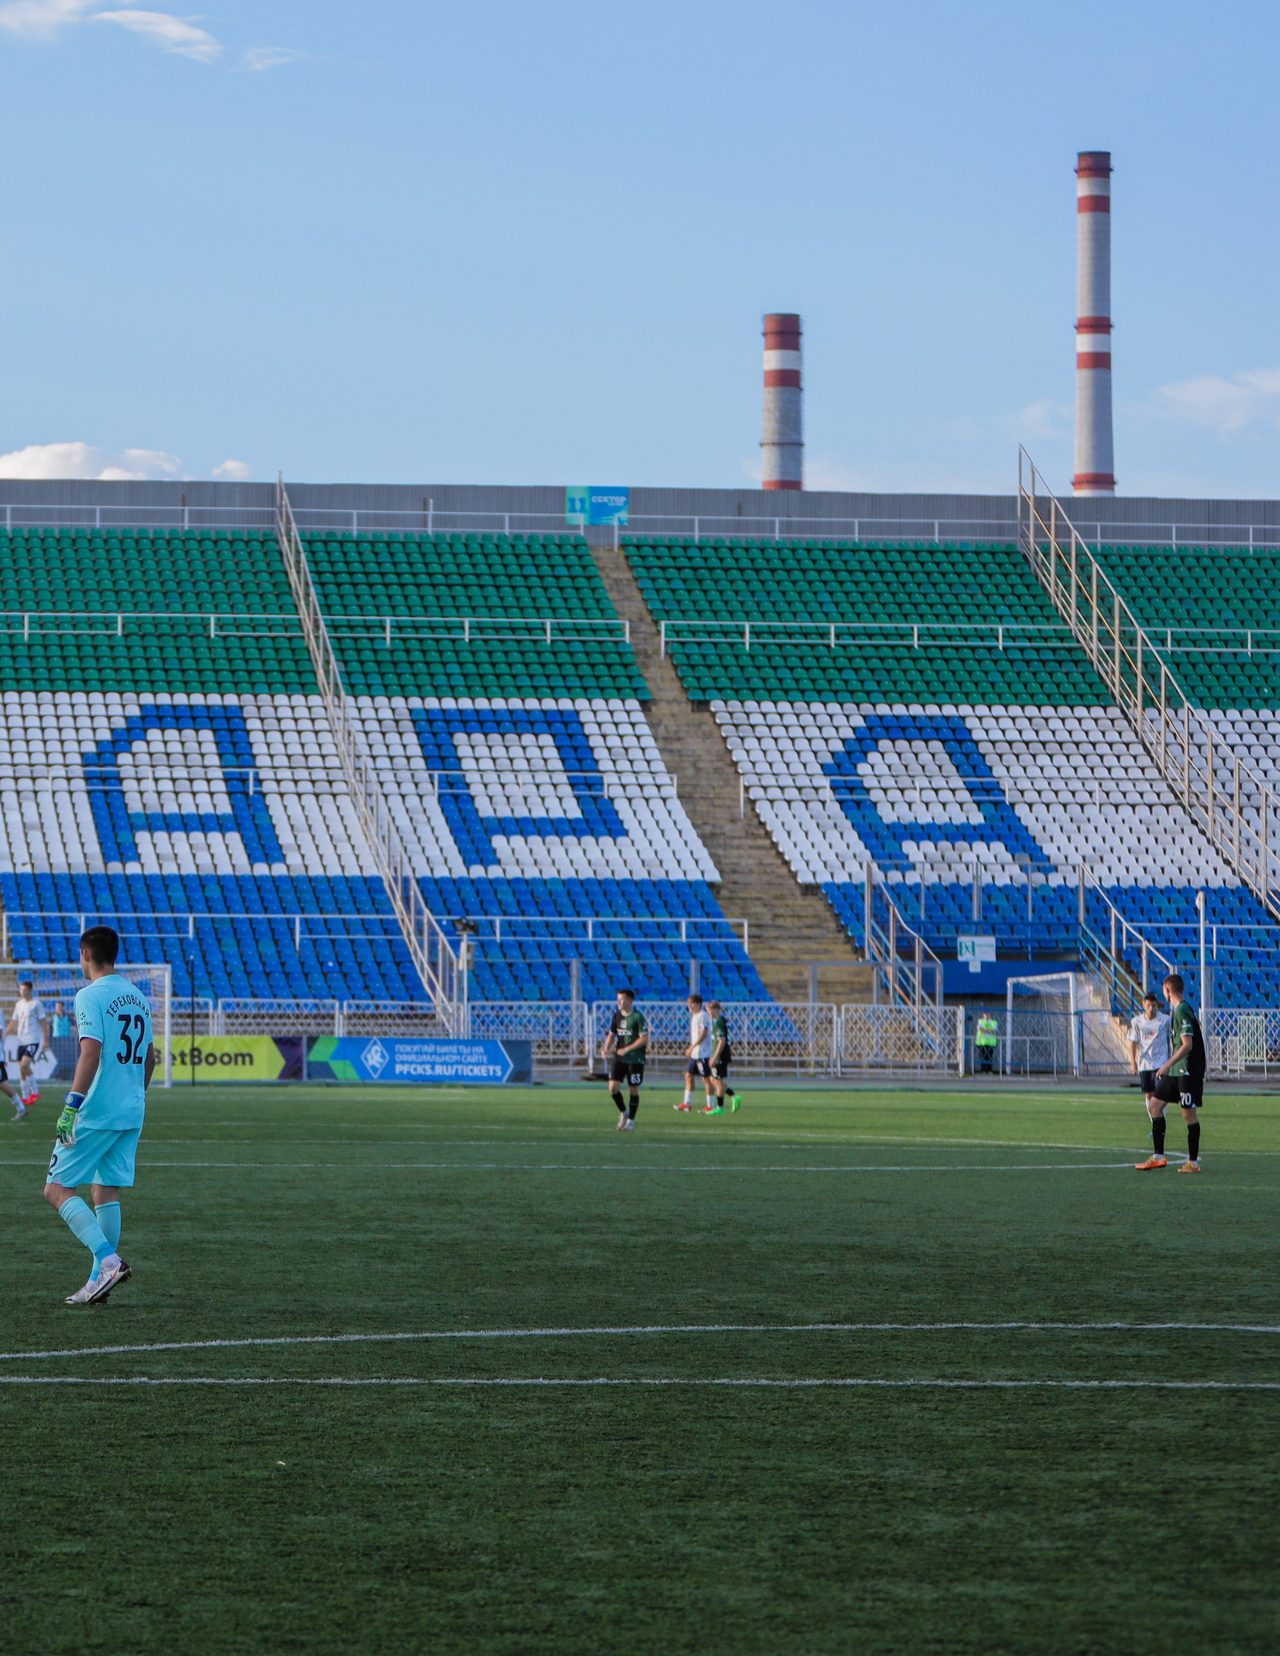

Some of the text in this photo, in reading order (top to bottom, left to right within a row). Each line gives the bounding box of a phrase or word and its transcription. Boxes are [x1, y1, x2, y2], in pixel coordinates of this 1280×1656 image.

[116, 1013, 145, 1065] 32
[395, 1044, 484, 1054] ПОКУПАЙ БИЛЕТЫ НА
[395, 1063, 502, 1077] PFCKS.RU/TICKETS
[630, 1073, 641, 1084] 63
[1180, 1092, 1192, 1106] 70
